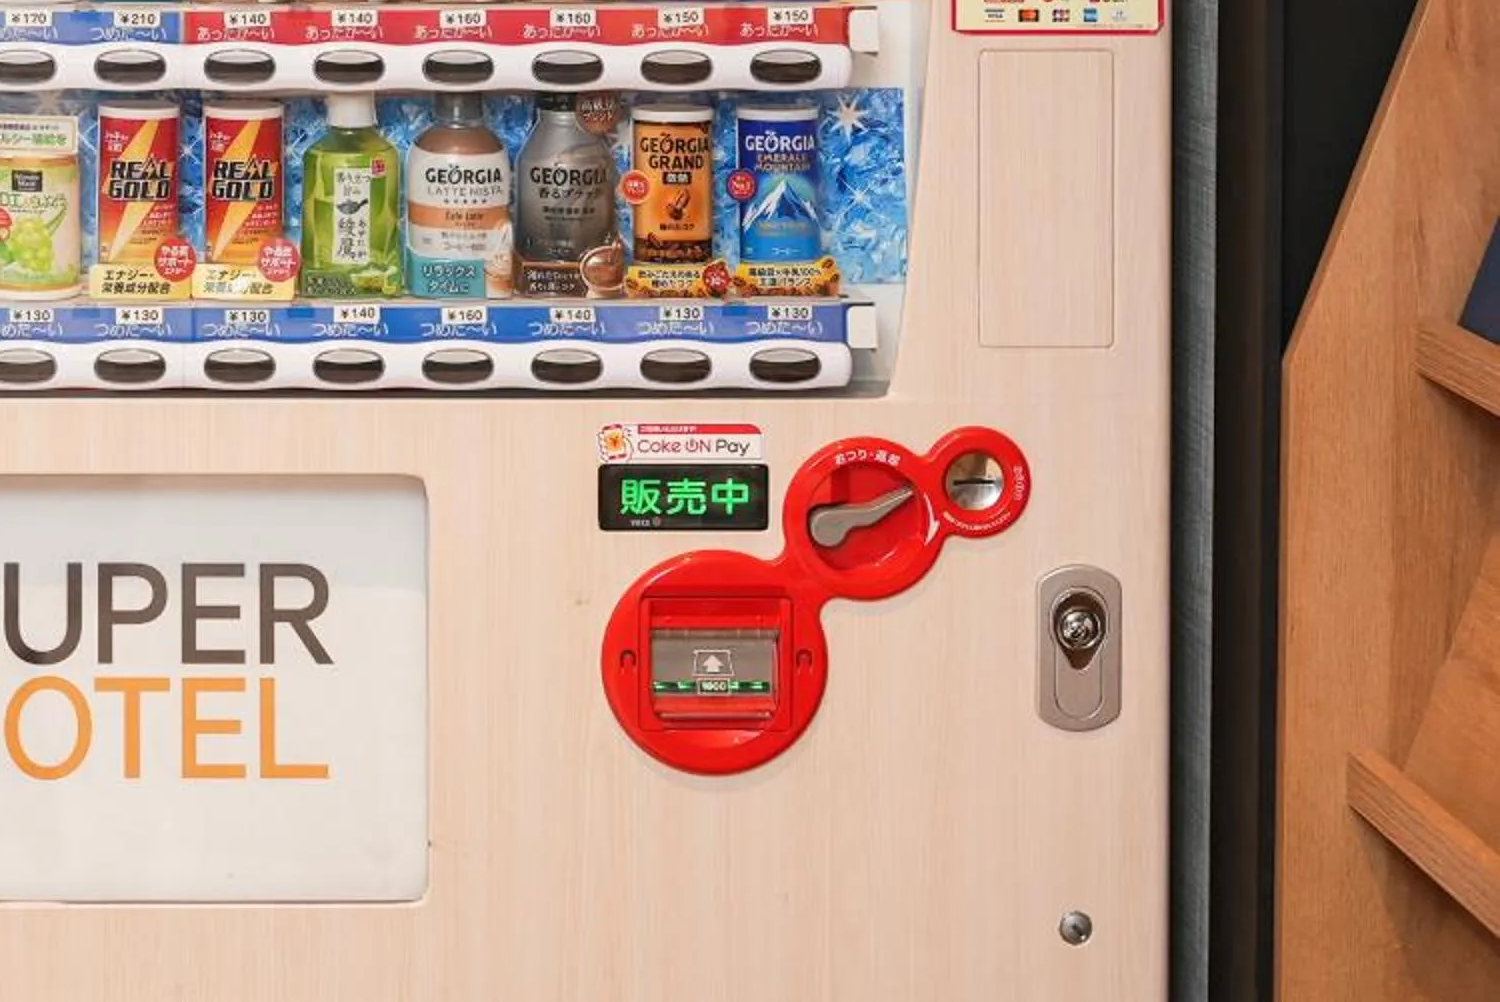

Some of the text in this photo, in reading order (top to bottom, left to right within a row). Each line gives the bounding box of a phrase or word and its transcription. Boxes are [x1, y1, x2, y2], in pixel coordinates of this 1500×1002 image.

[11, 13, 47, 24] ¥170
[121, 14, 155, 25] ¥210
[229, 13, 267, 25] ¥140
[337, 12, 373, 24] ¥140
[445, 13, 481, 25] ¥160
[556, 13, 591, 24] ¥160
[663, 11, 700, 23] ¥150
[772, 10, 809, 22] ¥150
[640, 133, 709, 154] GEORGIA
[745, 131, 815, 151] GEORGIA
[110, 154, 171, 180] REAL
[214, 154, 272, 180] REAL
[650, 156, 704, 170] GRAND
[425, 164, 503, 185] GEORGIA
[531, 163, 607, 186] GEORGIA
[108, 179, 172, 202] GOLD
[212, 179, 272, 201] GOLD
[336, 218, 356, 260] 綾鷹
[101, 281, 171, 295] 栄養成分配合
[13, 309, 50, 321] ¥130
[121, 309, 159, 321] ¥130
[229, 311, 266, 322] ¥130
[340, 307, 375, 319] ¥140
[448, 309, 483, 321] ¥160
[555, 309, 591, 321] ¥140
[663, 307, 700, 319] ¥130
[771, 307, 809, 318] ¥130
[637, 438, 751, 457] Coke ON Pay
[620, 477, 750, 516] 販売中
